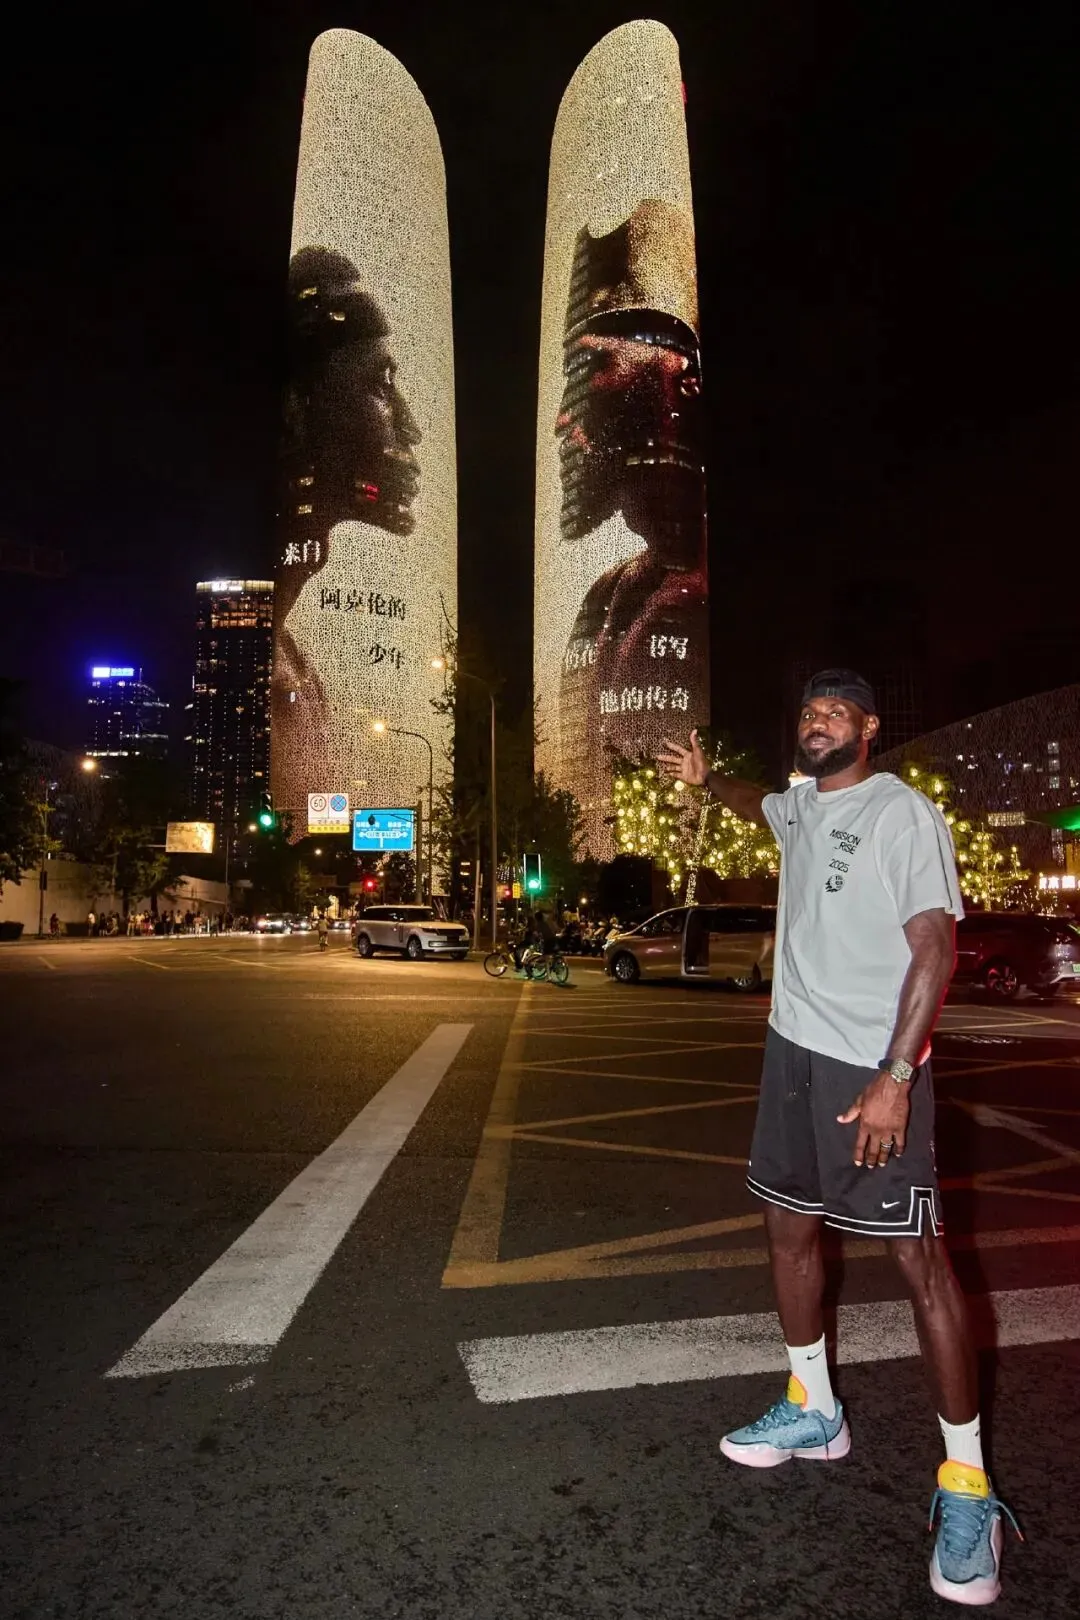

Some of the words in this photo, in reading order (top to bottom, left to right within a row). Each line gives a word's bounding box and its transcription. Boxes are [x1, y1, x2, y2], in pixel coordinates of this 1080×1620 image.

[283, 539, 321, 565] 来自
[320, 588, 406, 621] 阿克伦的
[368, 643, 405, 670] 少年
[599, 685, 689, 714] 他的传奇
[313, 799, 323, 808] 60
[829, 829, 861, 845] MISSION
[829, 859, 850, 873] 2025
